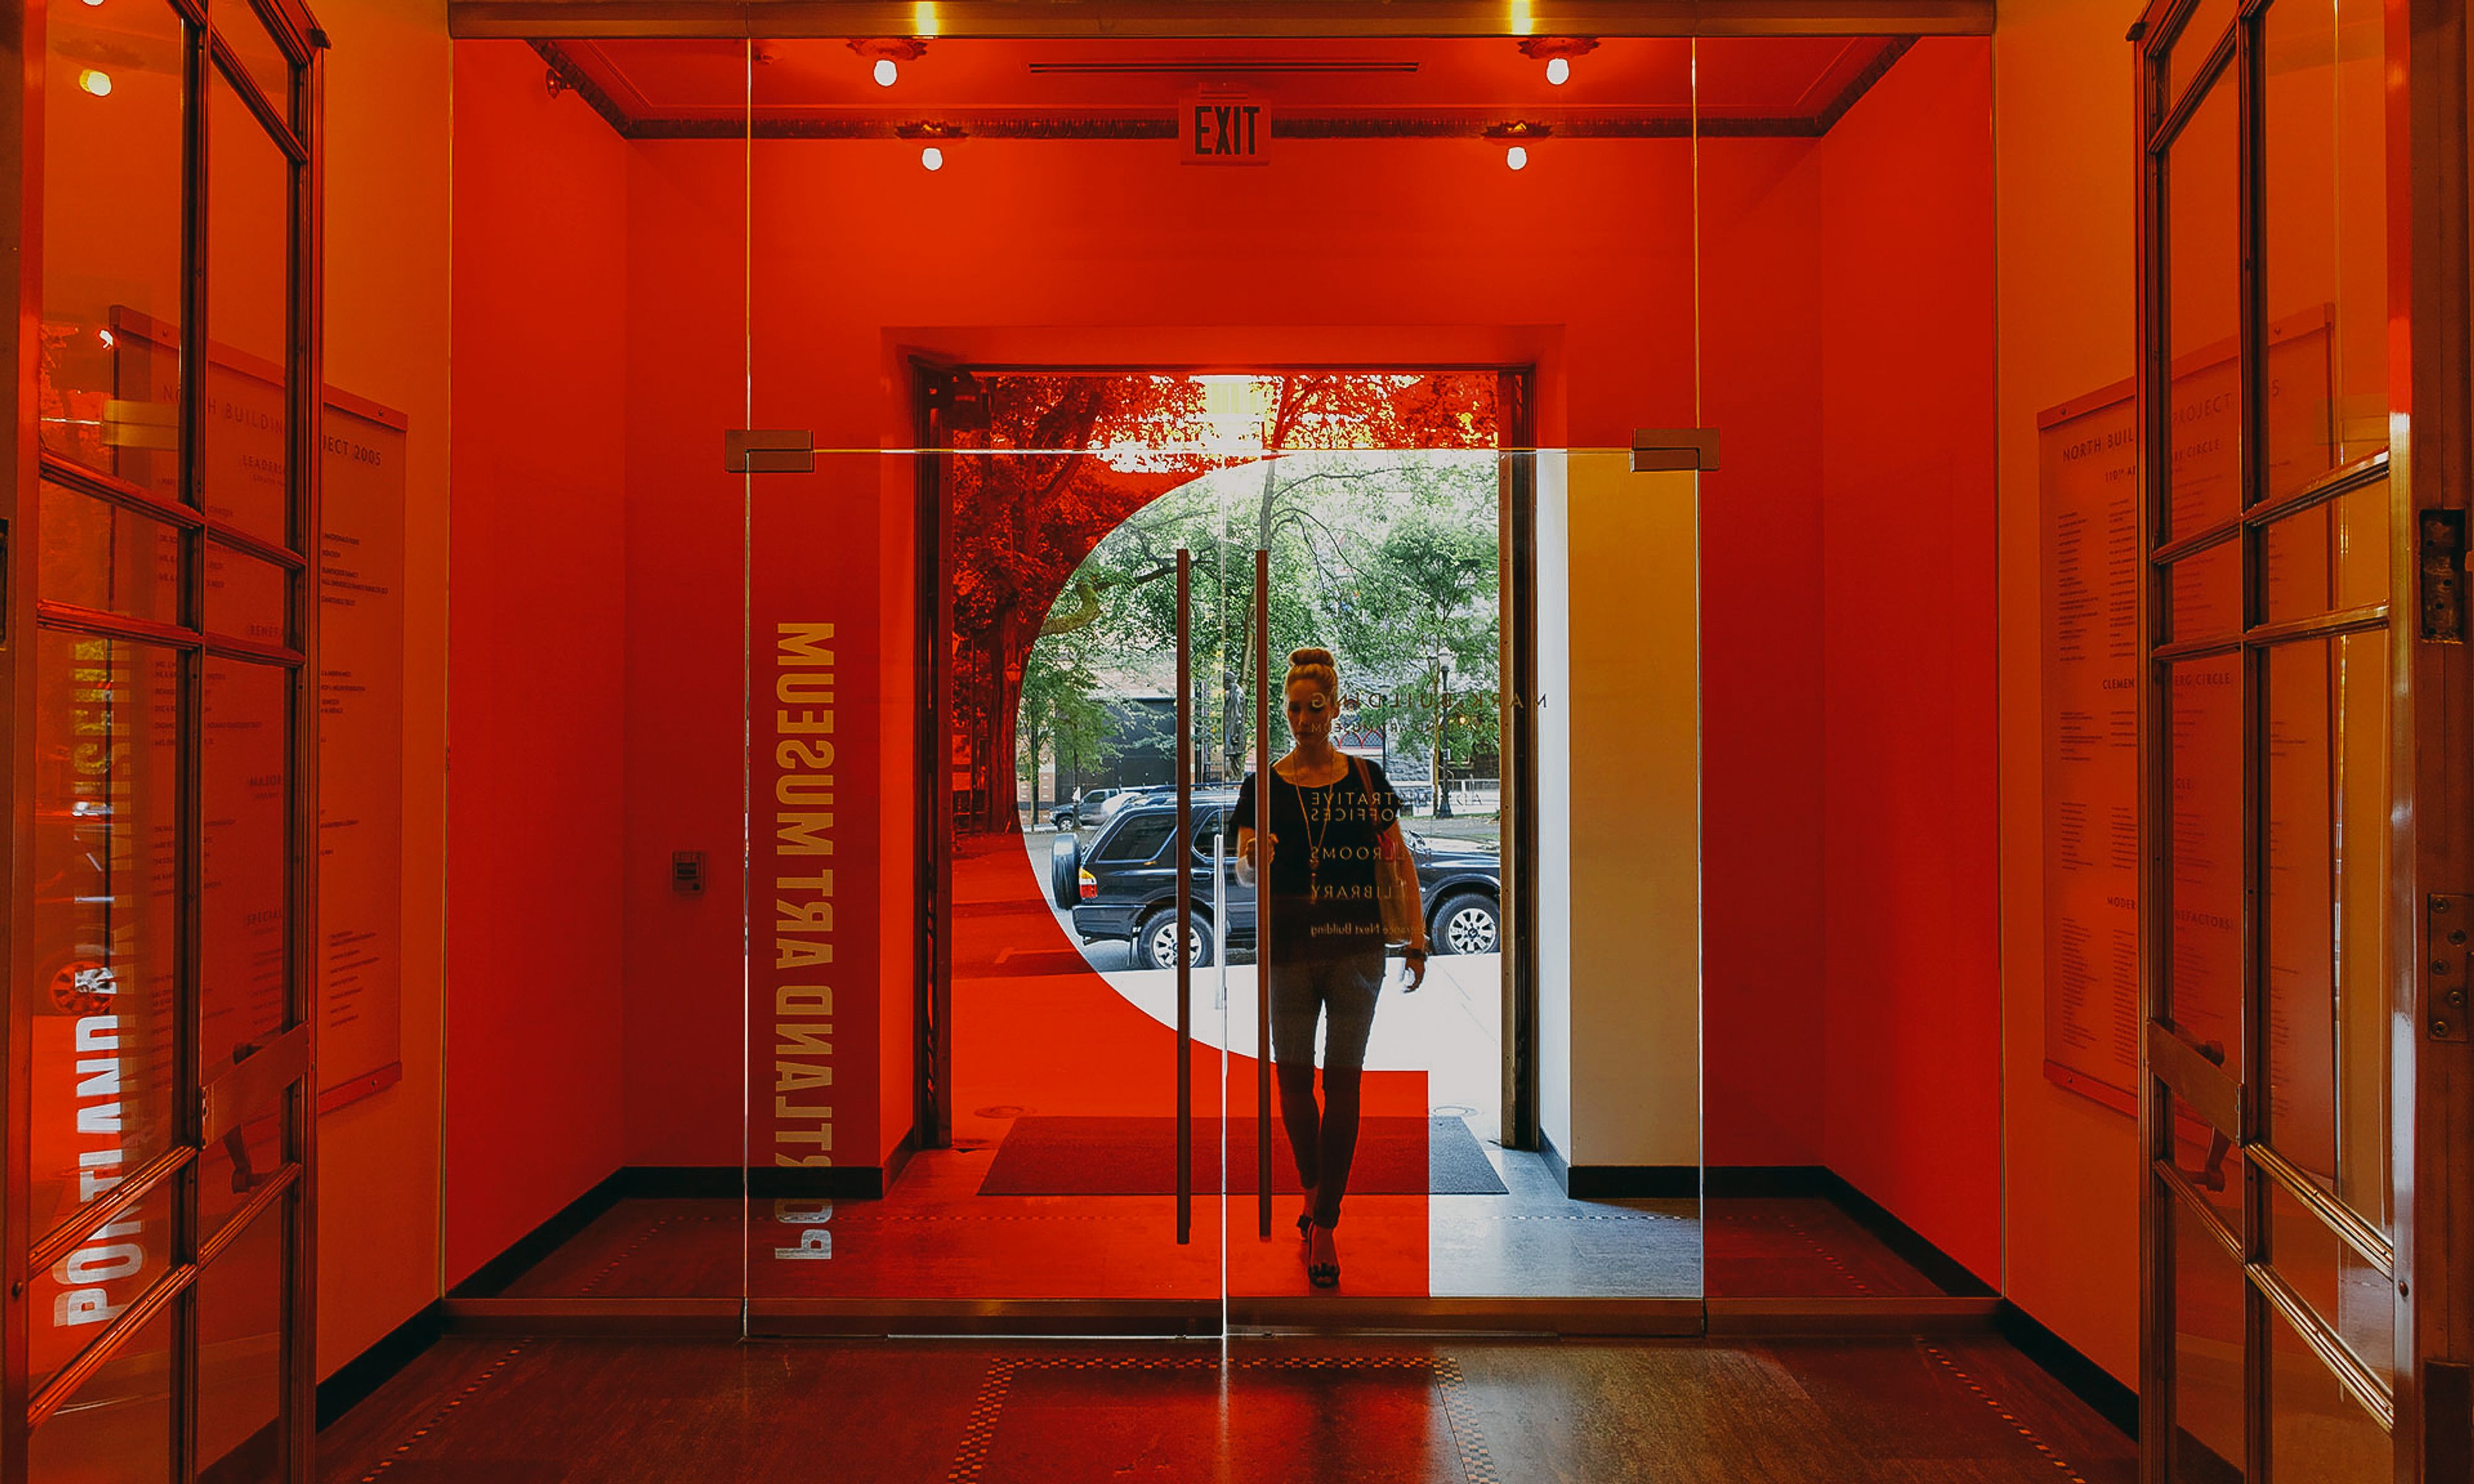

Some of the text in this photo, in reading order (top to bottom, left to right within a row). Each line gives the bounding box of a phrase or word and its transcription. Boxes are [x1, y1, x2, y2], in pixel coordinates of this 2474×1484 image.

[1194, 105, 1260, 155] EXIT
[226, 403, 283, 433] BUILDIN
[354, 444, 381, 466] 2005
[2062, 438, 2102, 463] NORTH
